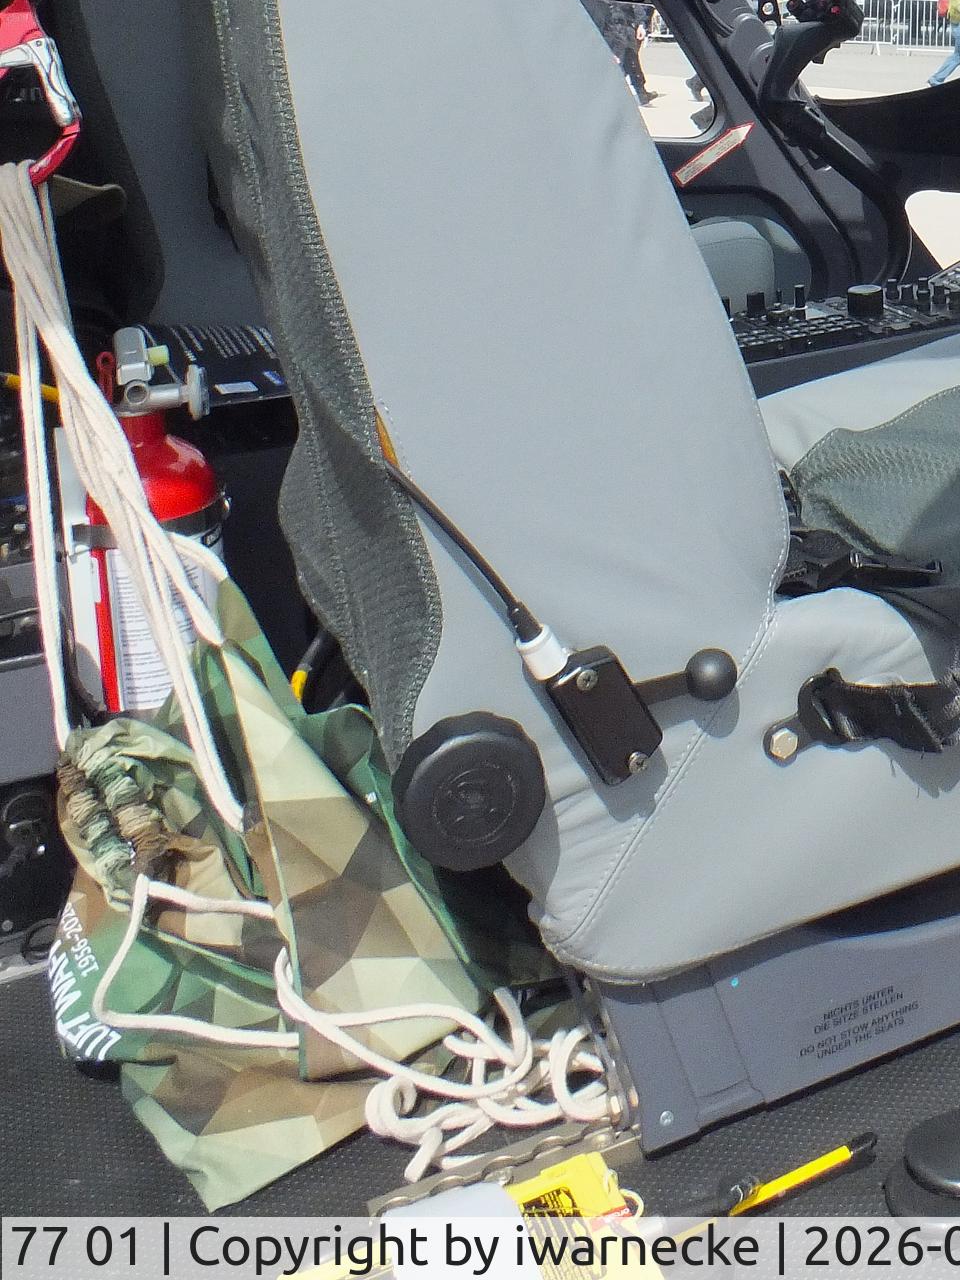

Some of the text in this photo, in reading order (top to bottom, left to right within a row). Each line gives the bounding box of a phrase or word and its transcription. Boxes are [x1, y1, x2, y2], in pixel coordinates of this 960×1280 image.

[814, 991, 904, 1035] DIE SITZE STELLEN
[823, 985, 894, 1021] NICHTS UNTER
[800, 1000, 919, 1057] DO NOT STOW ANYTHING
[817, 1017, 905, 1060] UNDER THE SEATS
